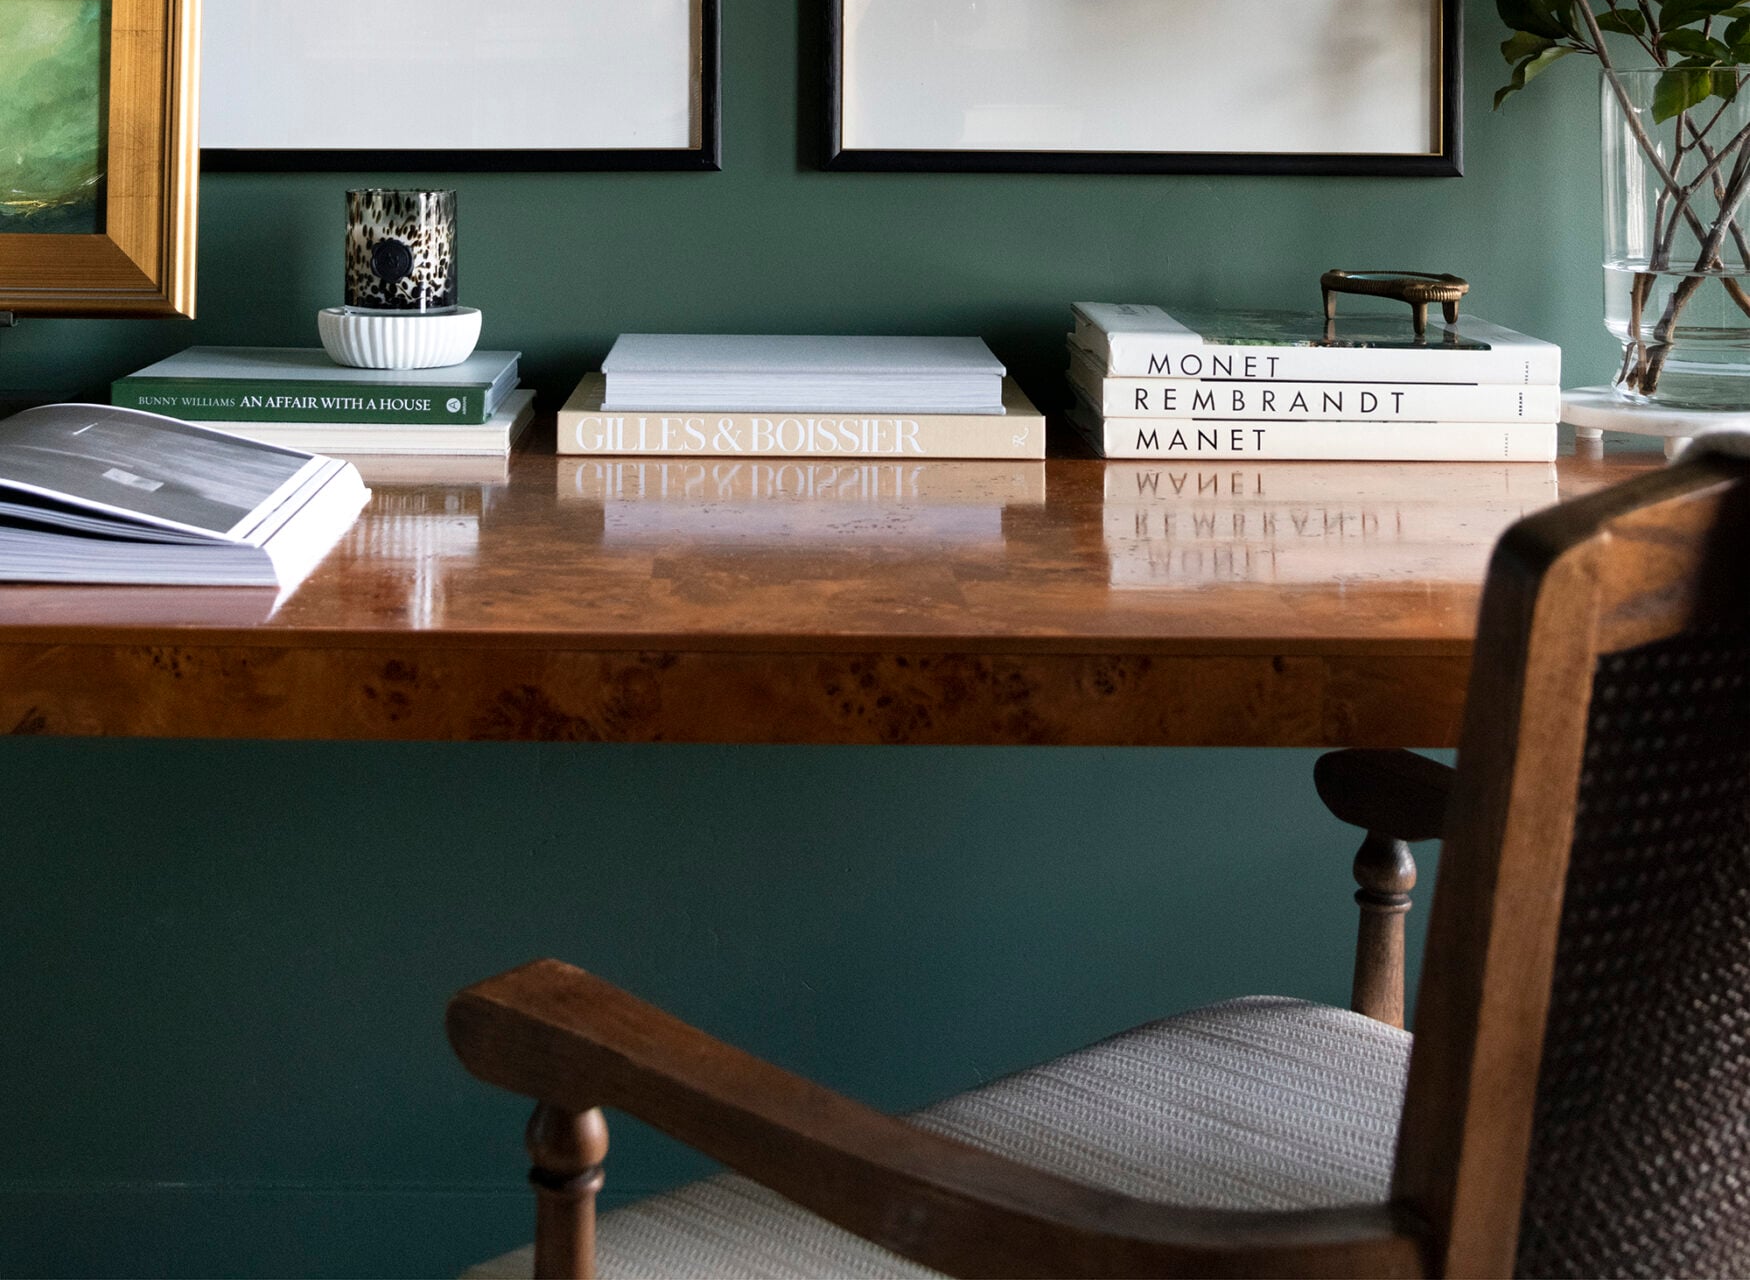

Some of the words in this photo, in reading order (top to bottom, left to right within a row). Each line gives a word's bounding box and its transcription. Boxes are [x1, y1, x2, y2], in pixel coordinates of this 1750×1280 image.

[1147, 353, 1280, 378] MONET
[138, 396, 178, 406] BUNNY
[181, 397, 236, 407] WILLIAMS
[240, 396, 263, 408] AN
[265, 396, 319, 409] AFFAIR
[320, 397, 362, 410] WITH
[366, 398, 377, 410] A
[380, 398, 431, 411] HOUSE
[1134, 388, 1405, 414] REMBRANDT
[575, 416, 706, 451] GILLES
[712, 417, 743, 452] &
[751, 418, 926, 454] BOISSIER
[1136, 428, 1266, 451] MANET
